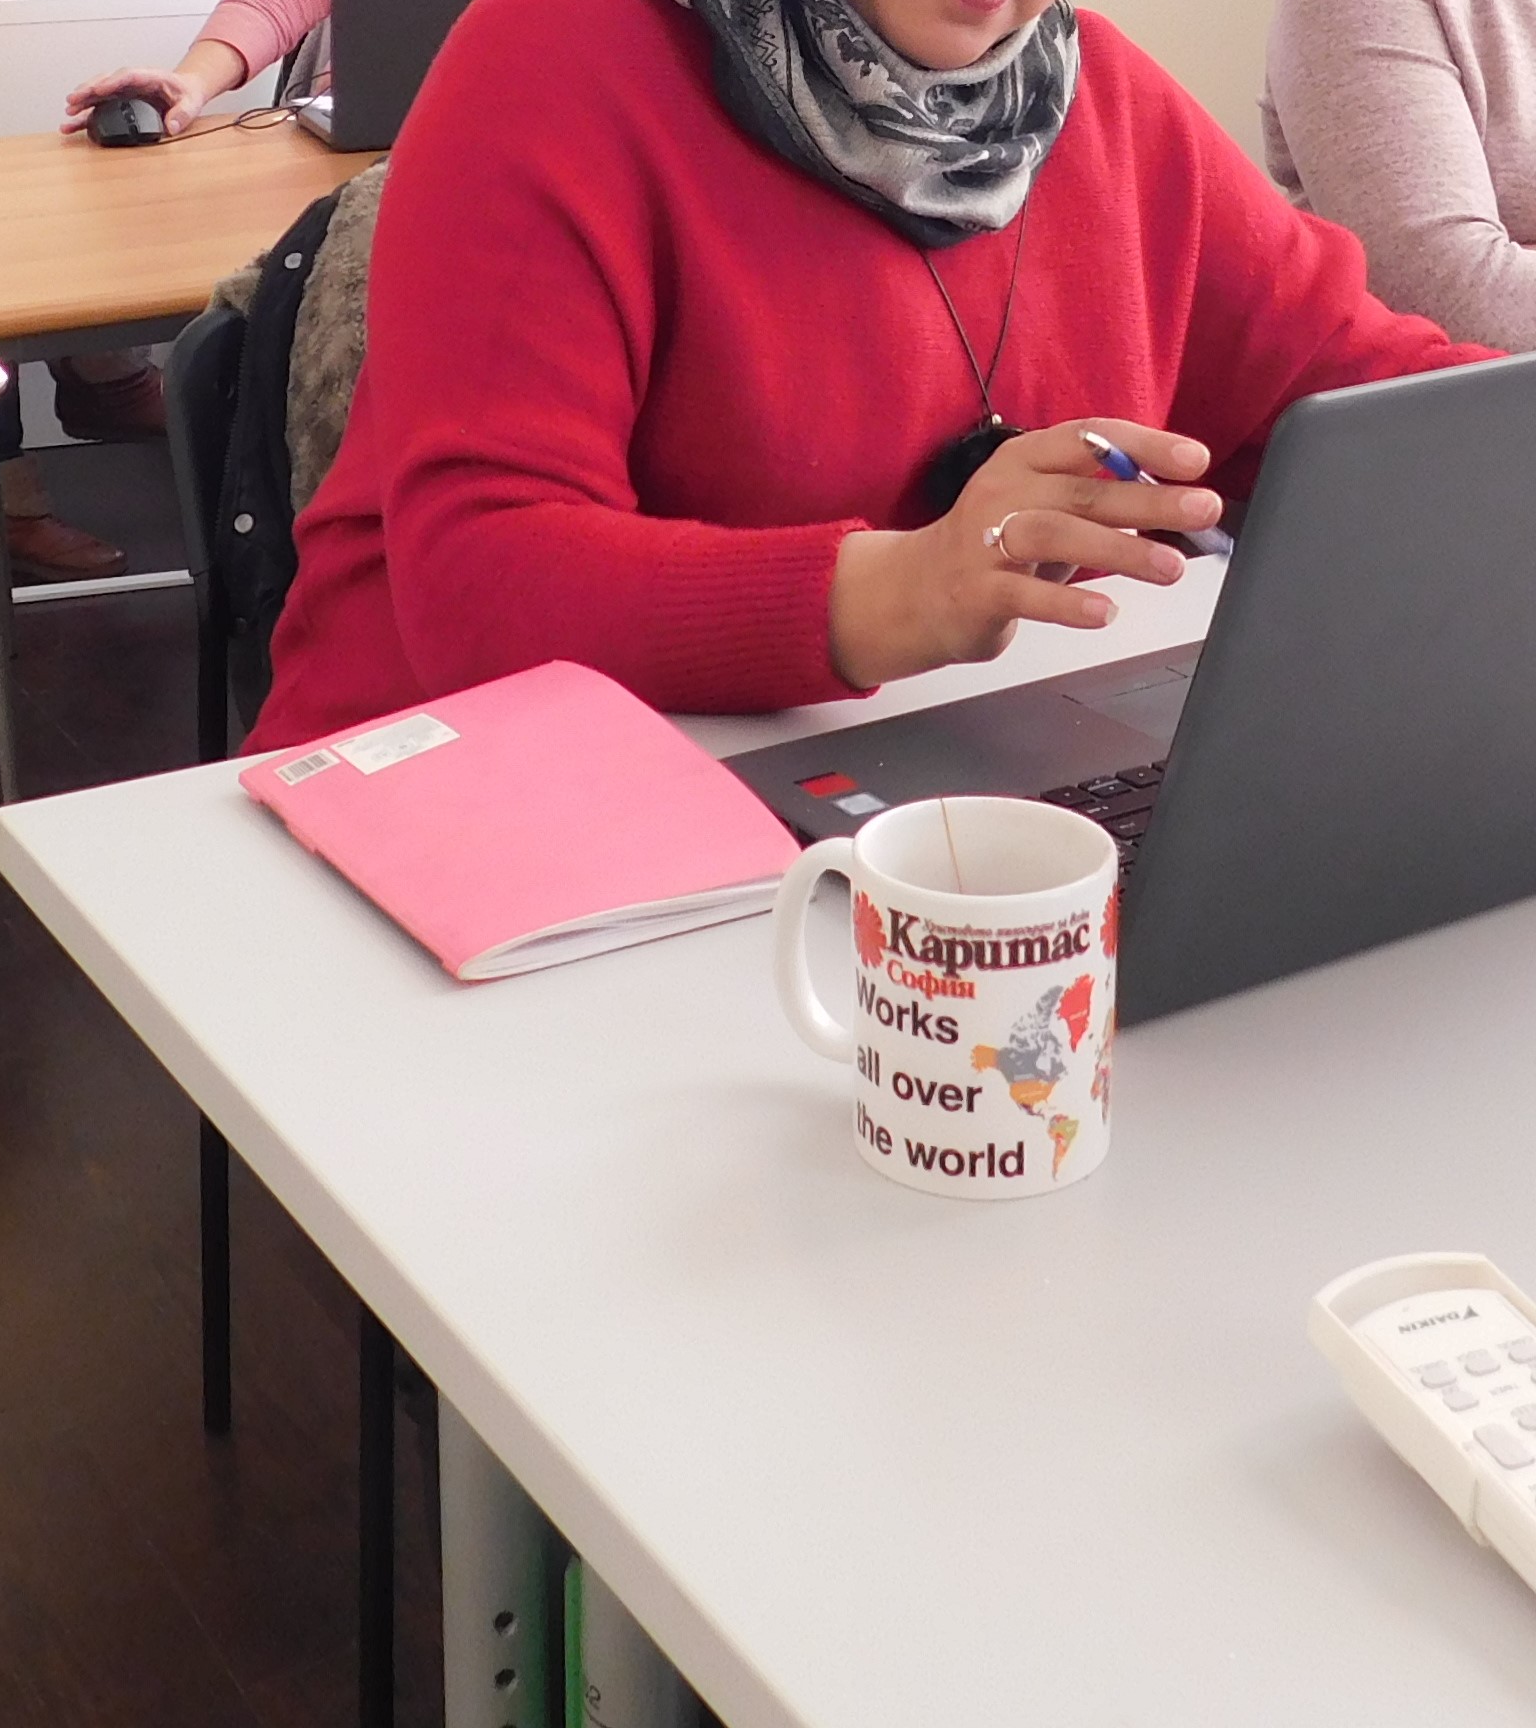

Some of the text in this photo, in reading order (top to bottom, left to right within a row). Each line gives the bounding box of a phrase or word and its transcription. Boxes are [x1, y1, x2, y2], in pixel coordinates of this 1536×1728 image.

[886, 907, 1092, 978] Каритас
[855, 968, 960, 1045] Works
[856, 1045, 983, 1113] all over
[856, 1098, 1026, 1178] the world
[1397, 1311, 1461, 1335] DAIKIN
